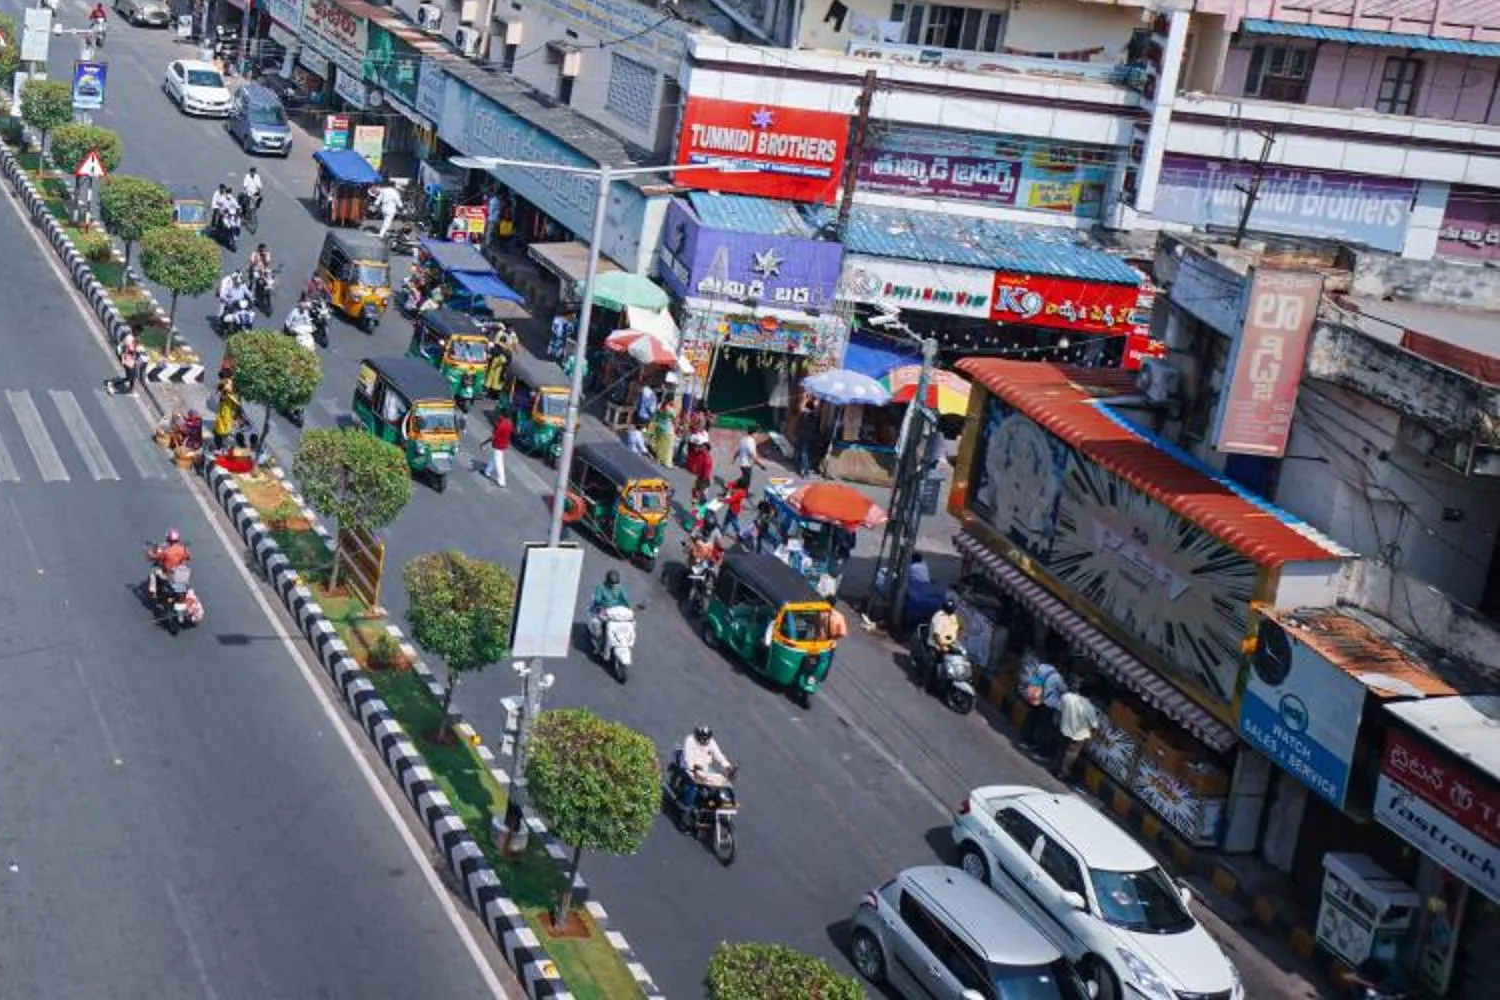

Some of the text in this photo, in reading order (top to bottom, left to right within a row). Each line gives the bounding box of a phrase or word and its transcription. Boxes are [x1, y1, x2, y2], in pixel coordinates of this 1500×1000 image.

[690, 122, 837, 162] TUMMIDI BROTHERS
[1299, 173, 1400, 227] Brothers
[995, 284, 1044, 319] K9
[1387, 795, 1497, 880] fastrack
